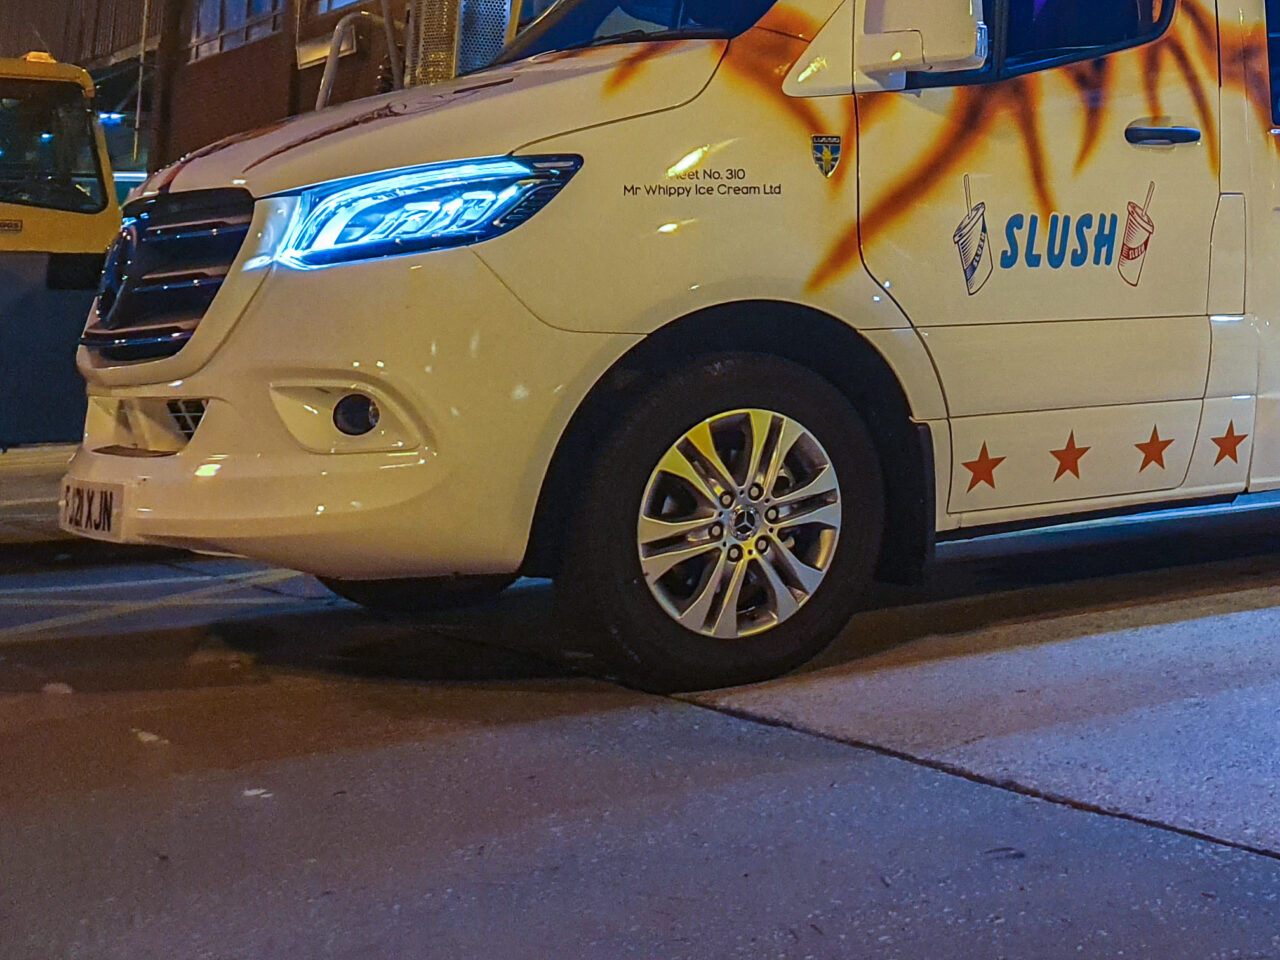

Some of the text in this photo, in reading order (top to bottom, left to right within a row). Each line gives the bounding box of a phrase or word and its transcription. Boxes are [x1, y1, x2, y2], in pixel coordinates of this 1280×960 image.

[703, 169, 723, 180] No.
[726, 169, 746, 180] 310
[623, 183, 782, 198] Mr Whippy Ice Cream Ltd
[1000, 213, 1118, 269] SLUSH
